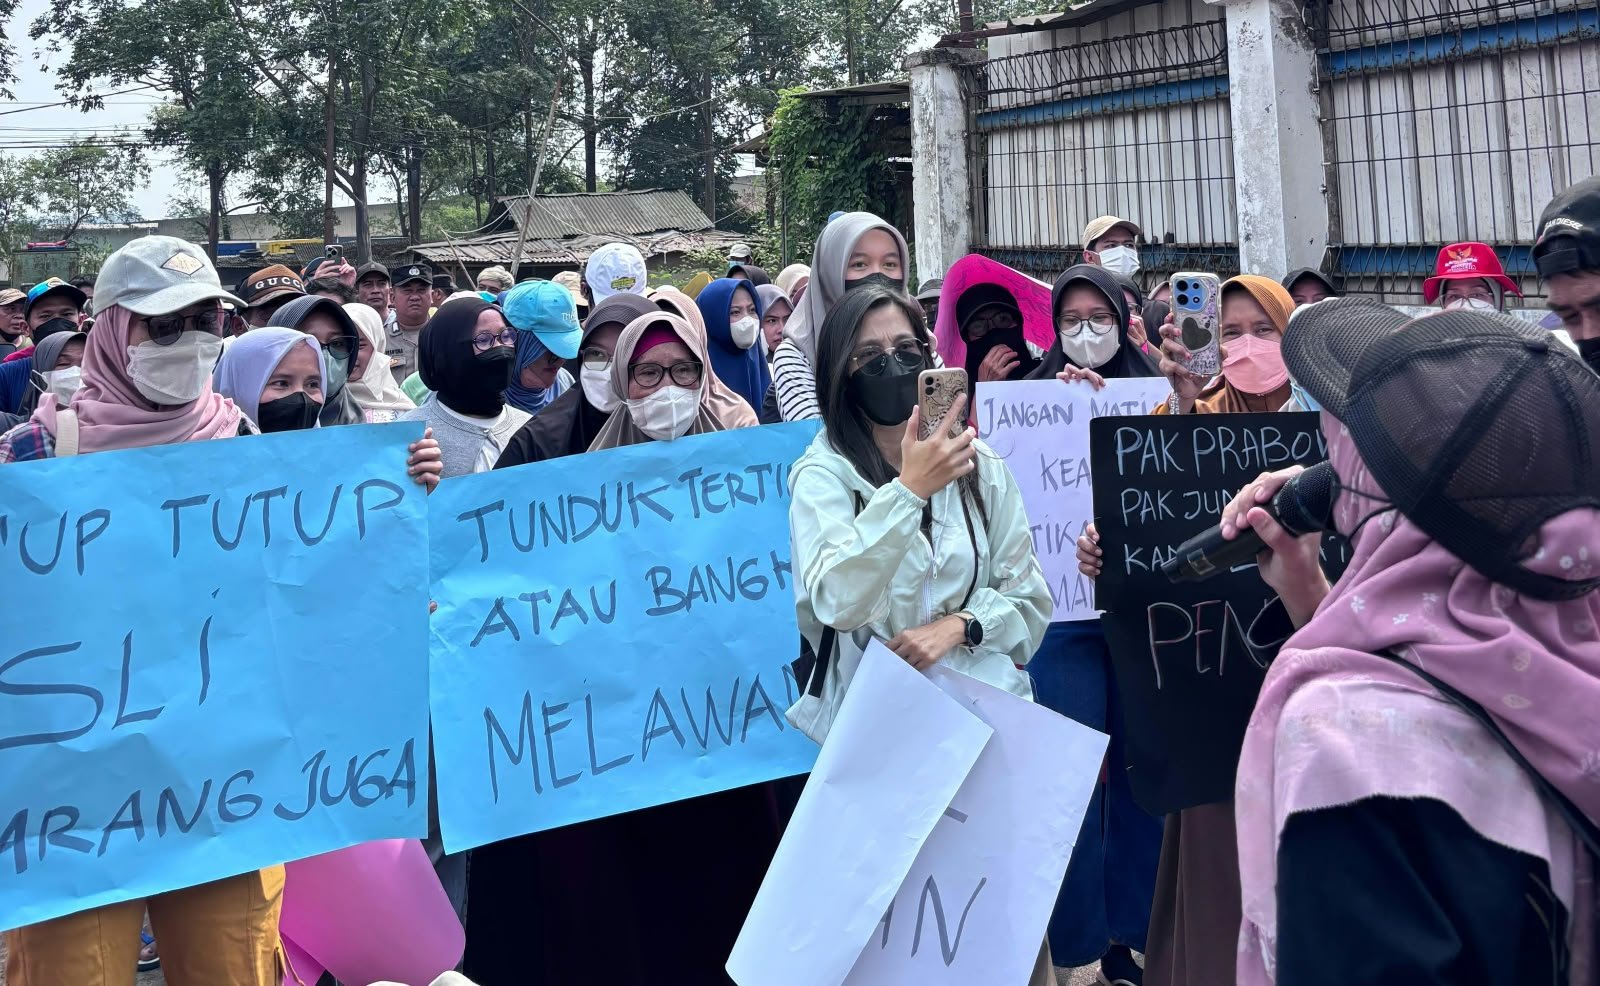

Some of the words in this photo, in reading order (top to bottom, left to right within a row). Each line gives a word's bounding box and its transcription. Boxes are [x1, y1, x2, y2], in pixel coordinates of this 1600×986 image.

[978, 398, 1074, 439] JANGAN
[1090, 391, 1158, 417] MATI
[1114, 427, 1184, 476] PAK
[0, 509, 111, 577] UP
[161, 478, 405, 558] TUTUP
[456, 480, 675, 563] TUNDUK
[678, 462, 793, 519] TERTI
[1121, 488, 1175, 527] PAK
[470, 579, 617, 648] ATAU
[274, 738, 416, 821] JUGA
